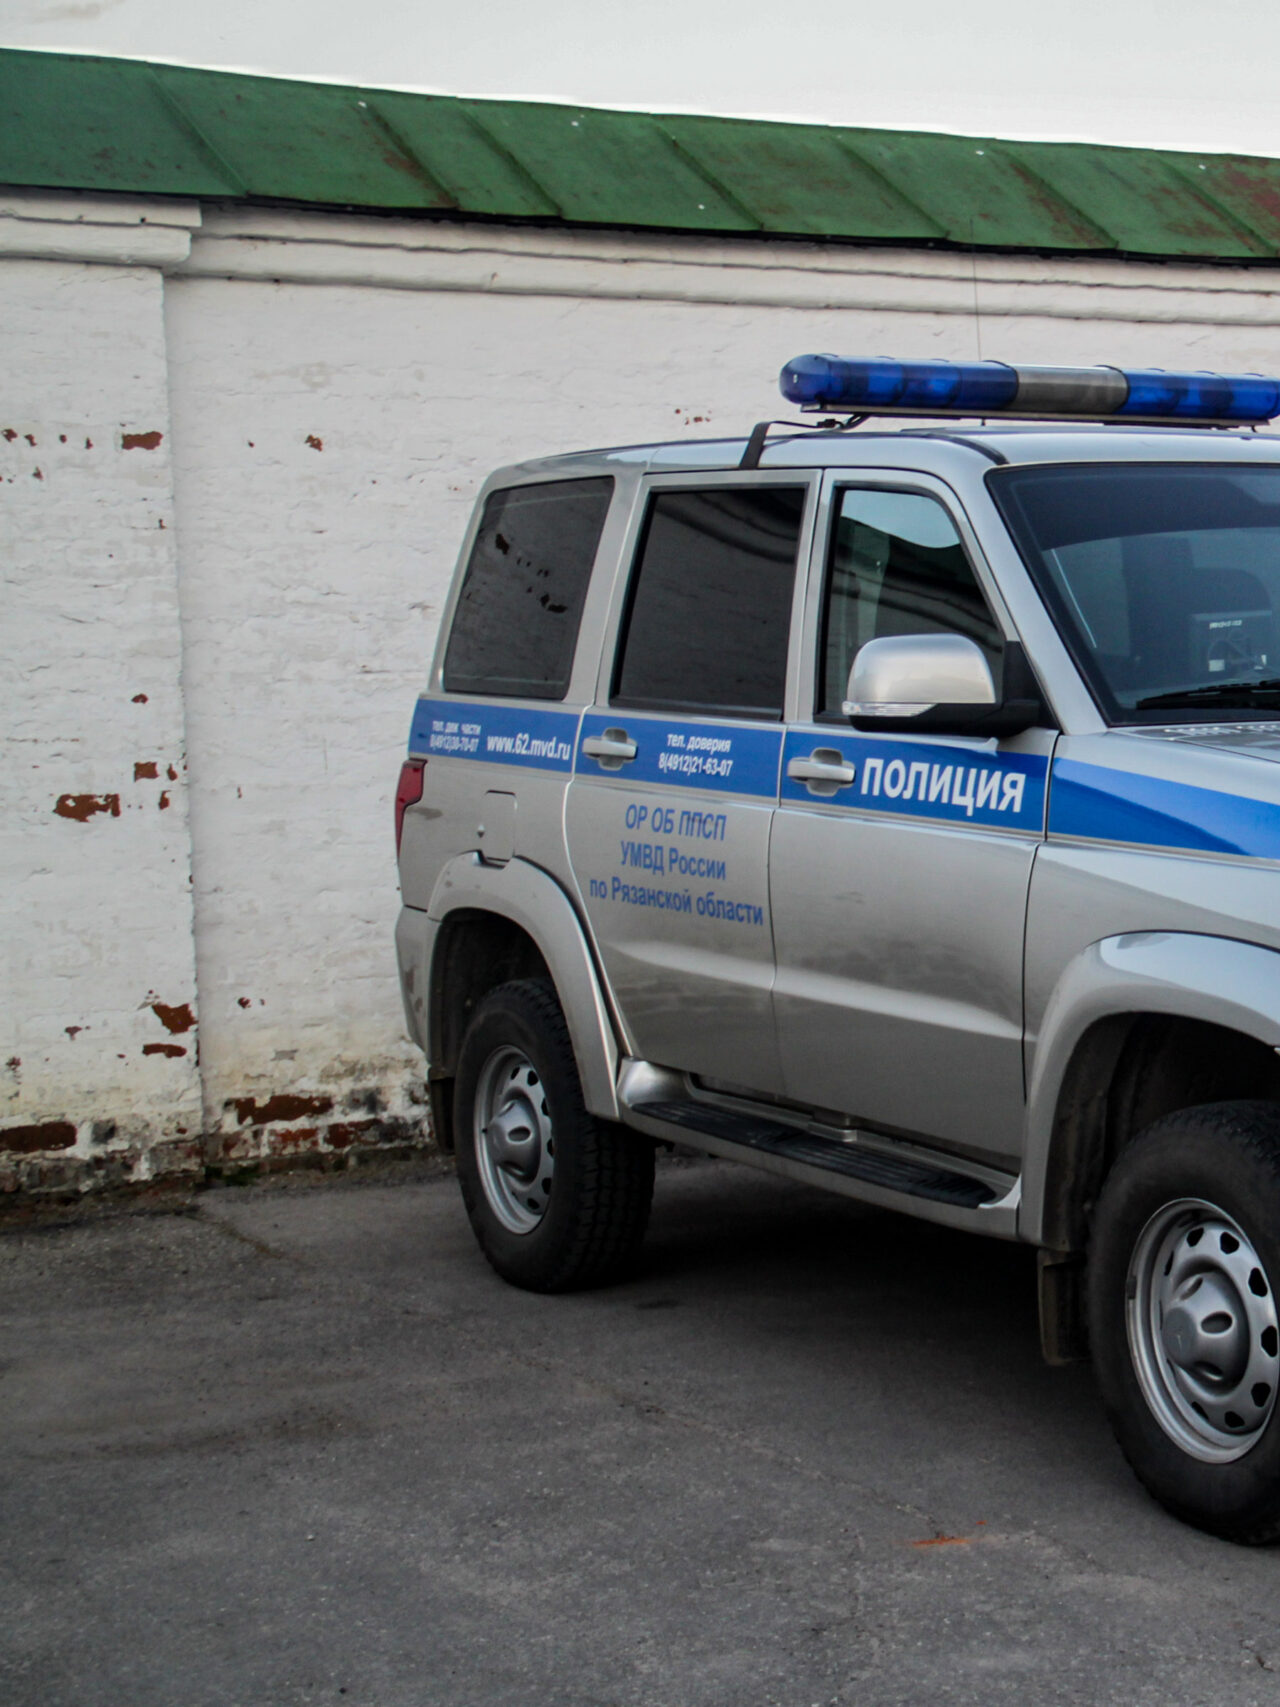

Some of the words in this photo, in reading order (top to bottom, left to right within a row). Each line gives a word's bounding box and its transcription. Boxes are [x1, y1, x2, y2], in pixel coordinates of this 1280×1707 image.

[487, 733, 571, 760] www.62.mvd.ru
[667, 733, 686, 748] тел.
[686, 736, 732, 755] доверия
[658, 752, 733, 776] 8(4912)21-63-07
[860, 757, 1027, 817] ПОЛИЦИЯ
[625, 804, 648, 829] ОР
[651, 807, 676, 834] ОБ
[678, 810, 727, 841] ППСП
[620, 840, 665, 876] УМВД
[668, 847, 726, 880] России
[589, 878, 608, 899] по
[611, 876, 693, 913] Рязанской
[696, 891, 764, 925] области
